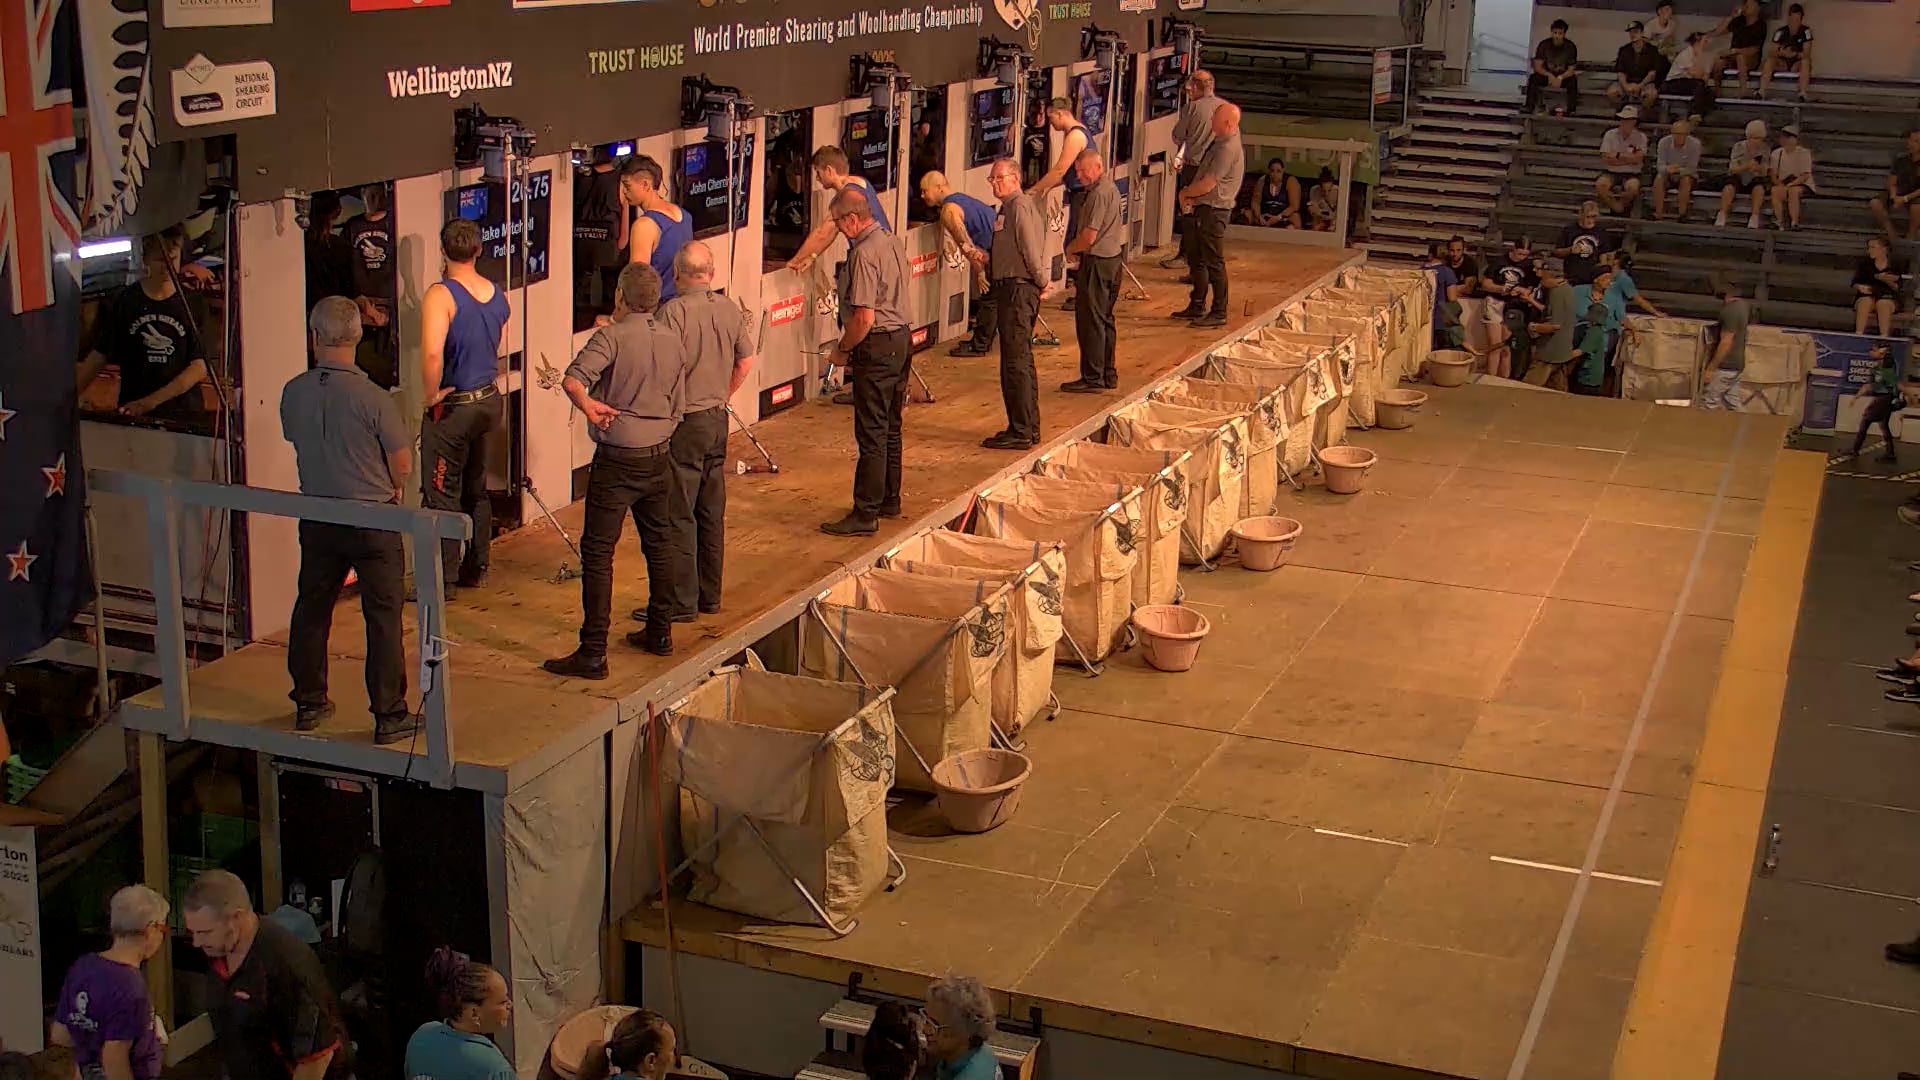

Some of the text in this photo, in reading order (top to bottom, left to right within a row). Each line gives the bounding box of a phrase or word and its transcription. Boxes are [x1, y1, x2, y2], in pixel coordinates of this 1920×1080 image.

[1049, 4, 1092, 20] TRUST HOUSE
[694, 2, 984, 55] World Premier Shearing and Woolhandling Championship
[588, 44, 685, 74] TRUST HOUSE
[234, 72, 270, 84] NATIONAL
[387, 62, 513, 98] WellingtonNZ
[235, 83, 270, 97] SHEARING
[236, 97, 263, 109] CIRCUIT
[690, 182, 706, 195] John
[0, 845, 28, 862] ton
